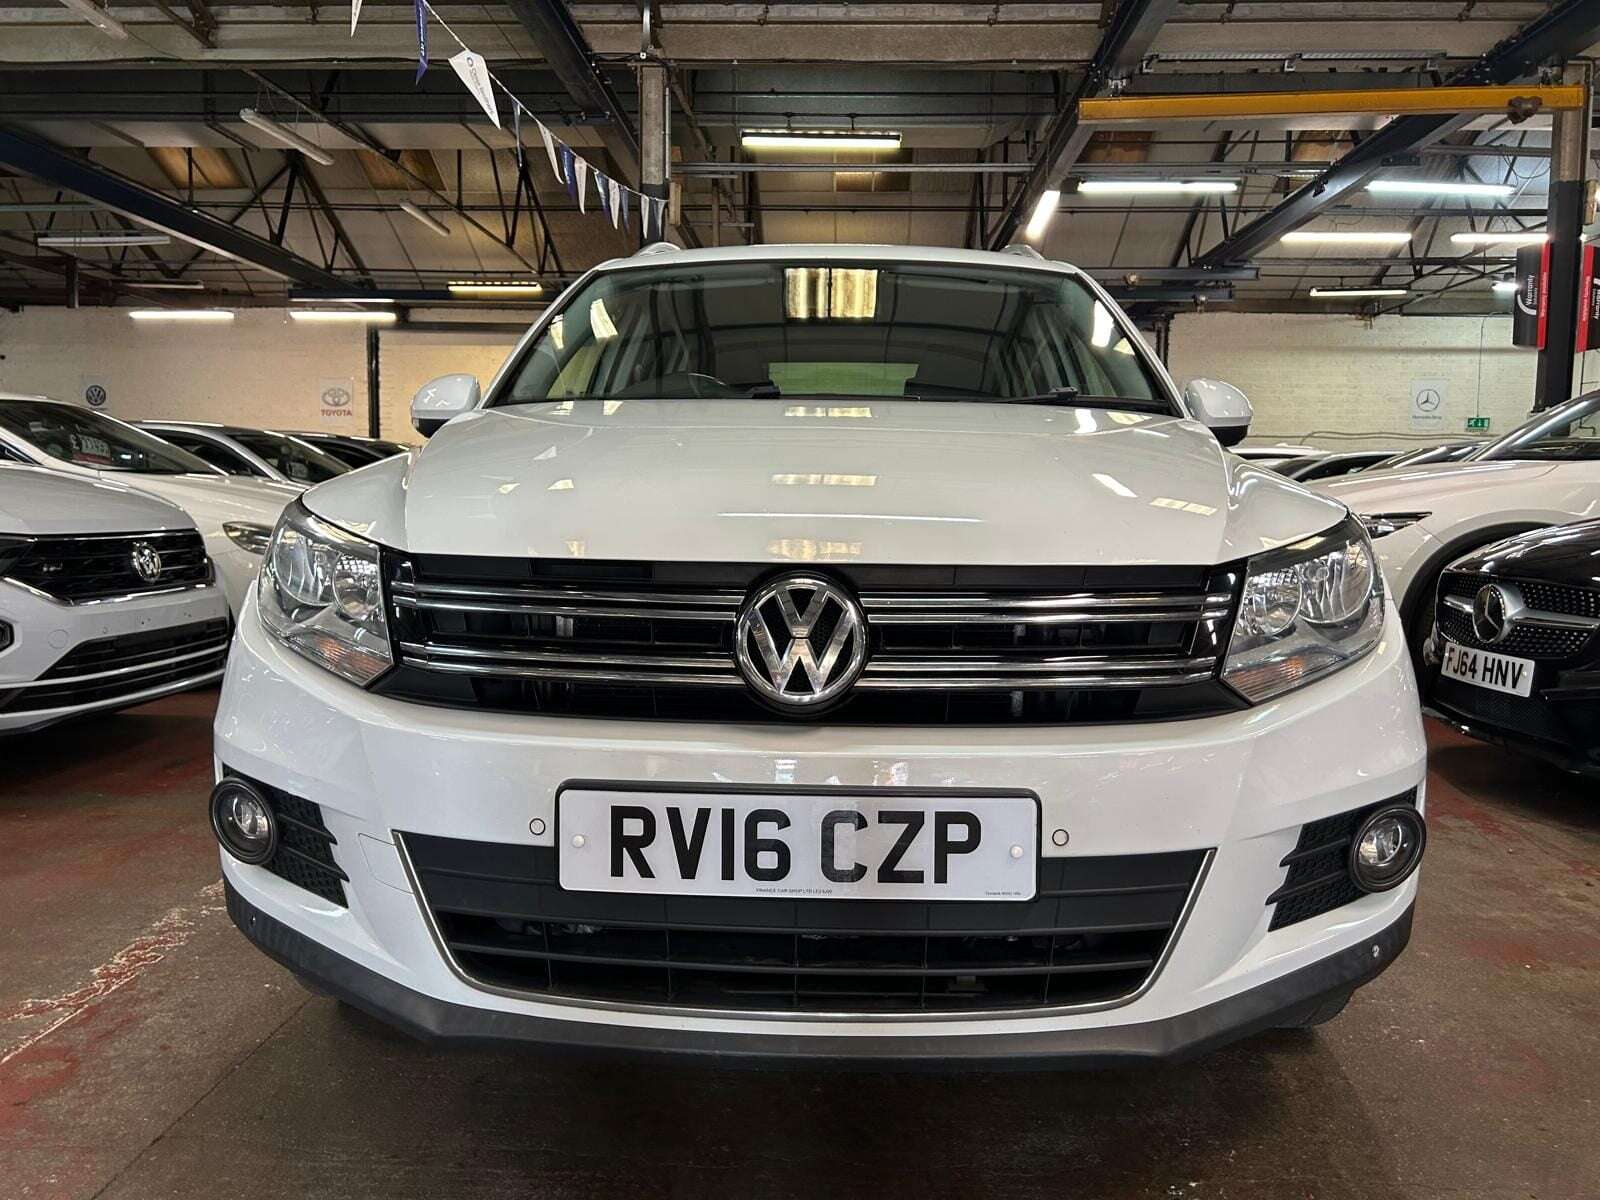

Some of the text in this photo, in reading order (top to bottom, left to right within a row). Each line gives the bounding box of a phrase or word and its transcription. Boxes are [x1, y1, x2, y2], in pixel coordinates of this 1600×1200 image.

[1525, 274, 1535, 306] Warranty
[320, 408, 353, 417] TOYOTA
[1445, 646, 1524, 689] FJ64 HNV
[609, 804, 983, 885] RV16 CZP
